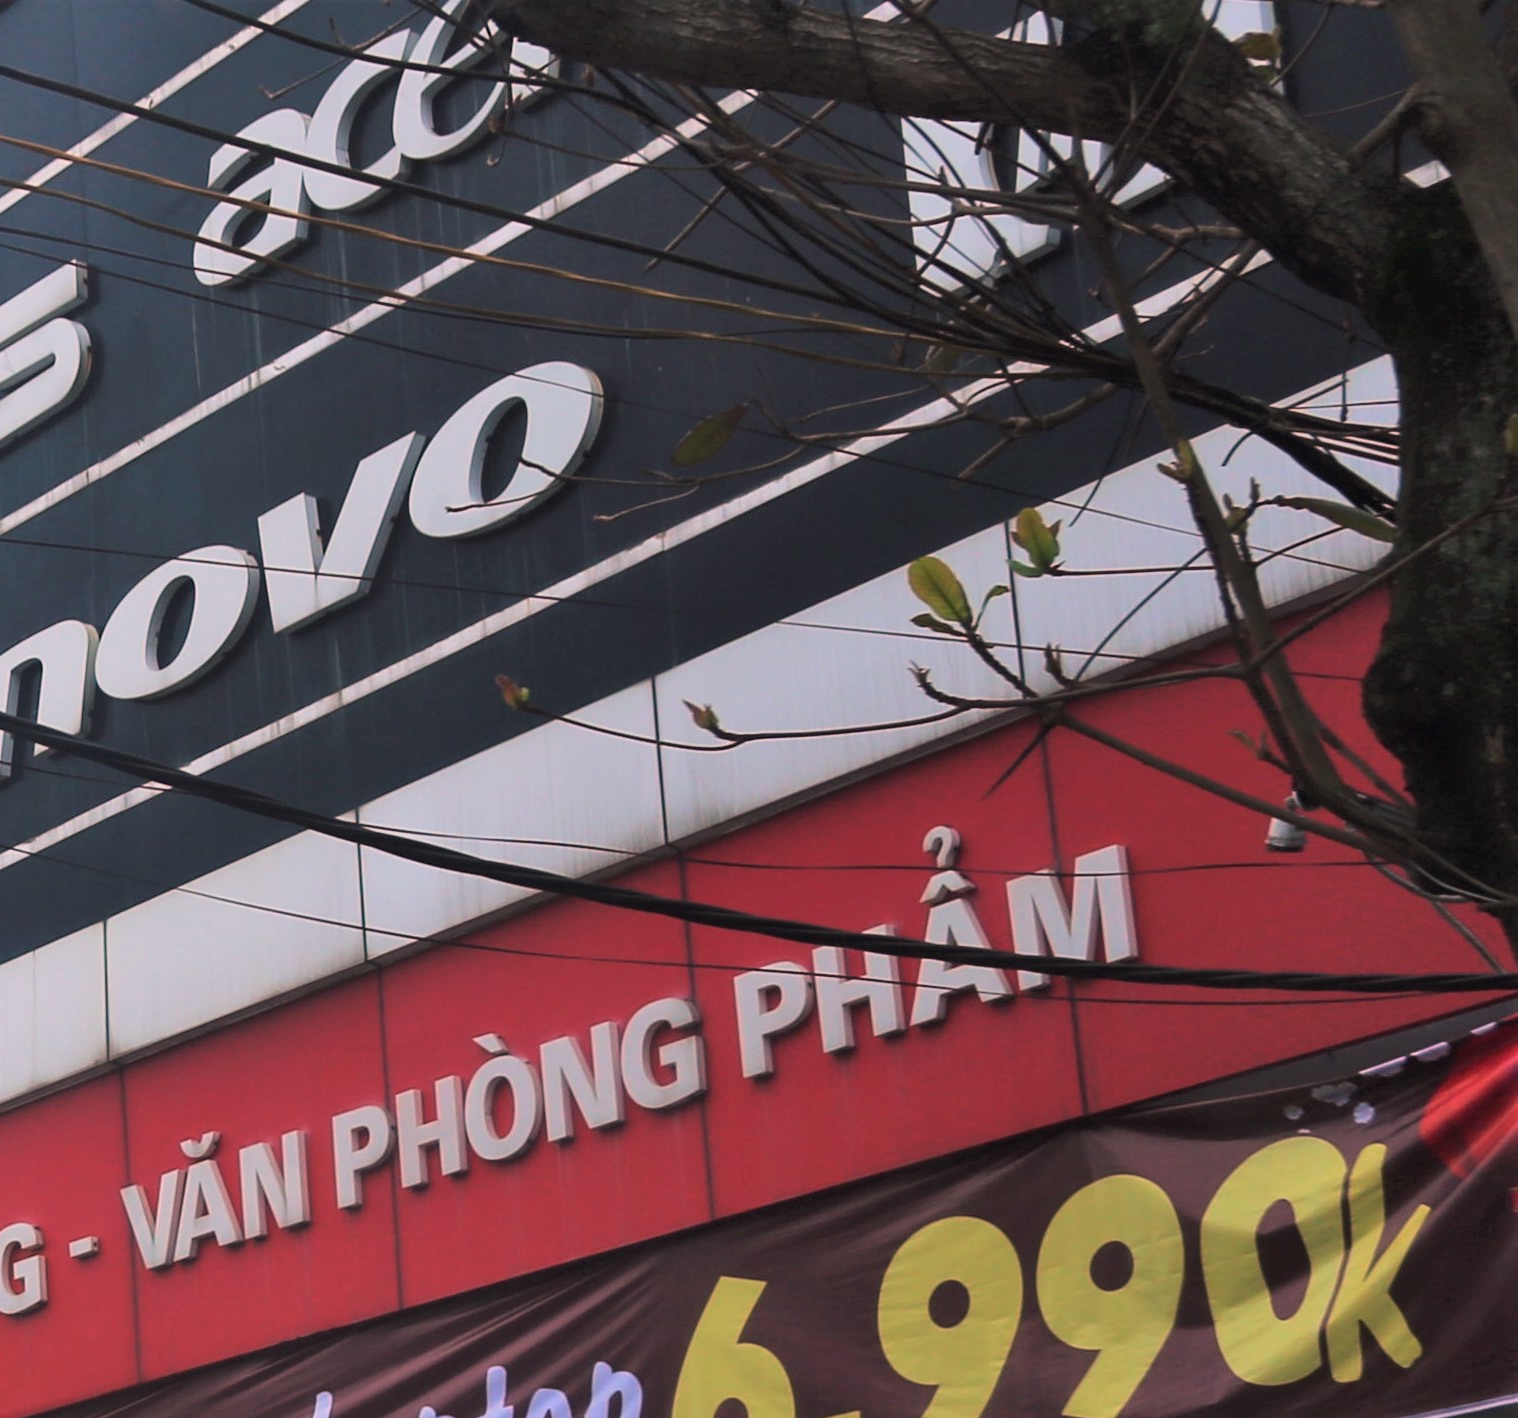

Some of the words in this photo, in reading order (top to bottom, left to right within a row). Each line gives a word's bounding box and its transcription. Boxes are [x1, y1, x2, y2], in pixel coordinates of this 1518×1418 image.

[119, 1130, 312, 1271] VĂN
[331, 997, 708, 1211] PHÒNG
[731, 825, 1141, 1080] PHẨM
